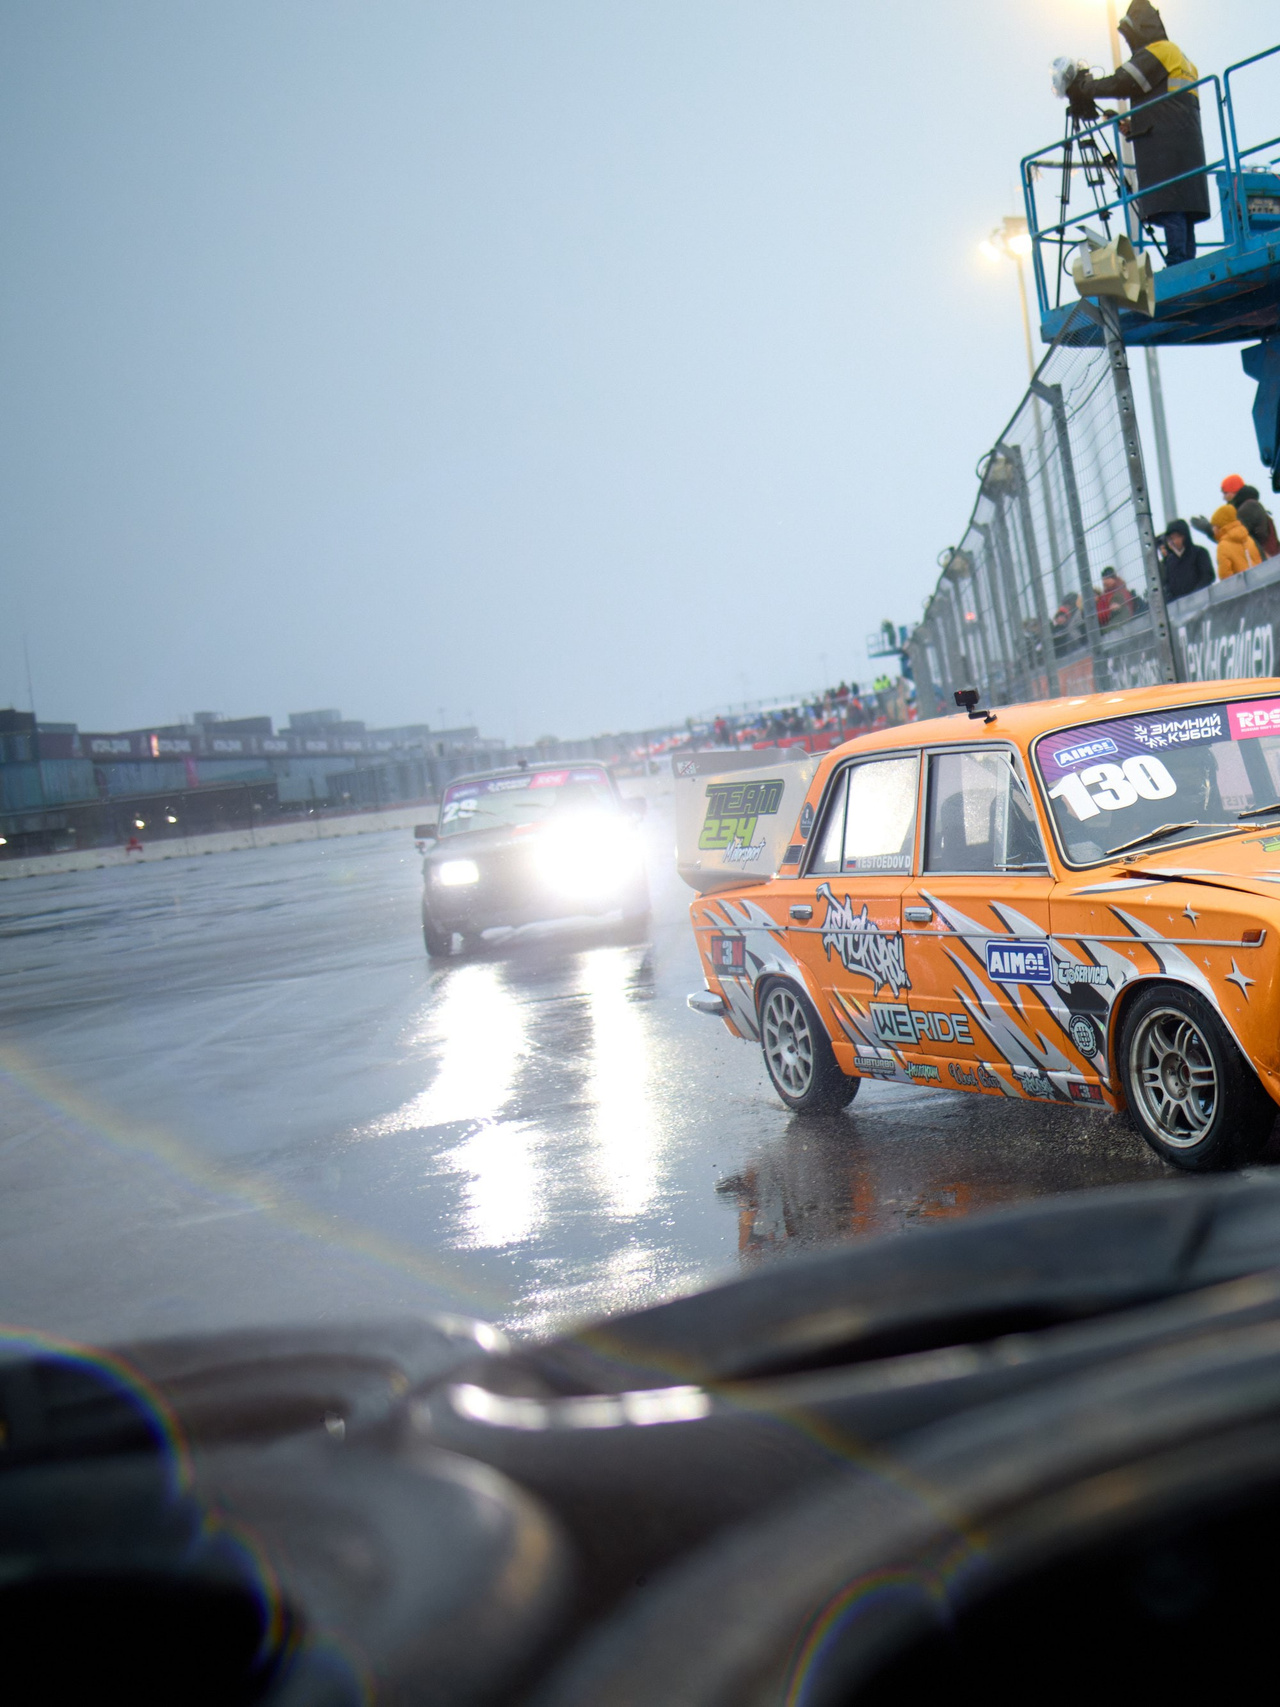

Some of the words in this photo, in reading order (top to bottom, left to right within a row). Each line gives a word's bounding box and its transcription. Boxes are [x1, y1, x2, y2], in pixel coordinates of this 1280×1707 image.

[1150, 713, 1221, 736] ЗИМНИЙ
[1168, 725, 1222, 744] КУБОК
[1059, 741, 1115, 765] AIMOL
[705, 780, 783, 817] TEAM
[1048, 755, 1177, 821] 130
[699, 816, 758, 850] 234
[990, 951, 1049, 976] AIMOL
